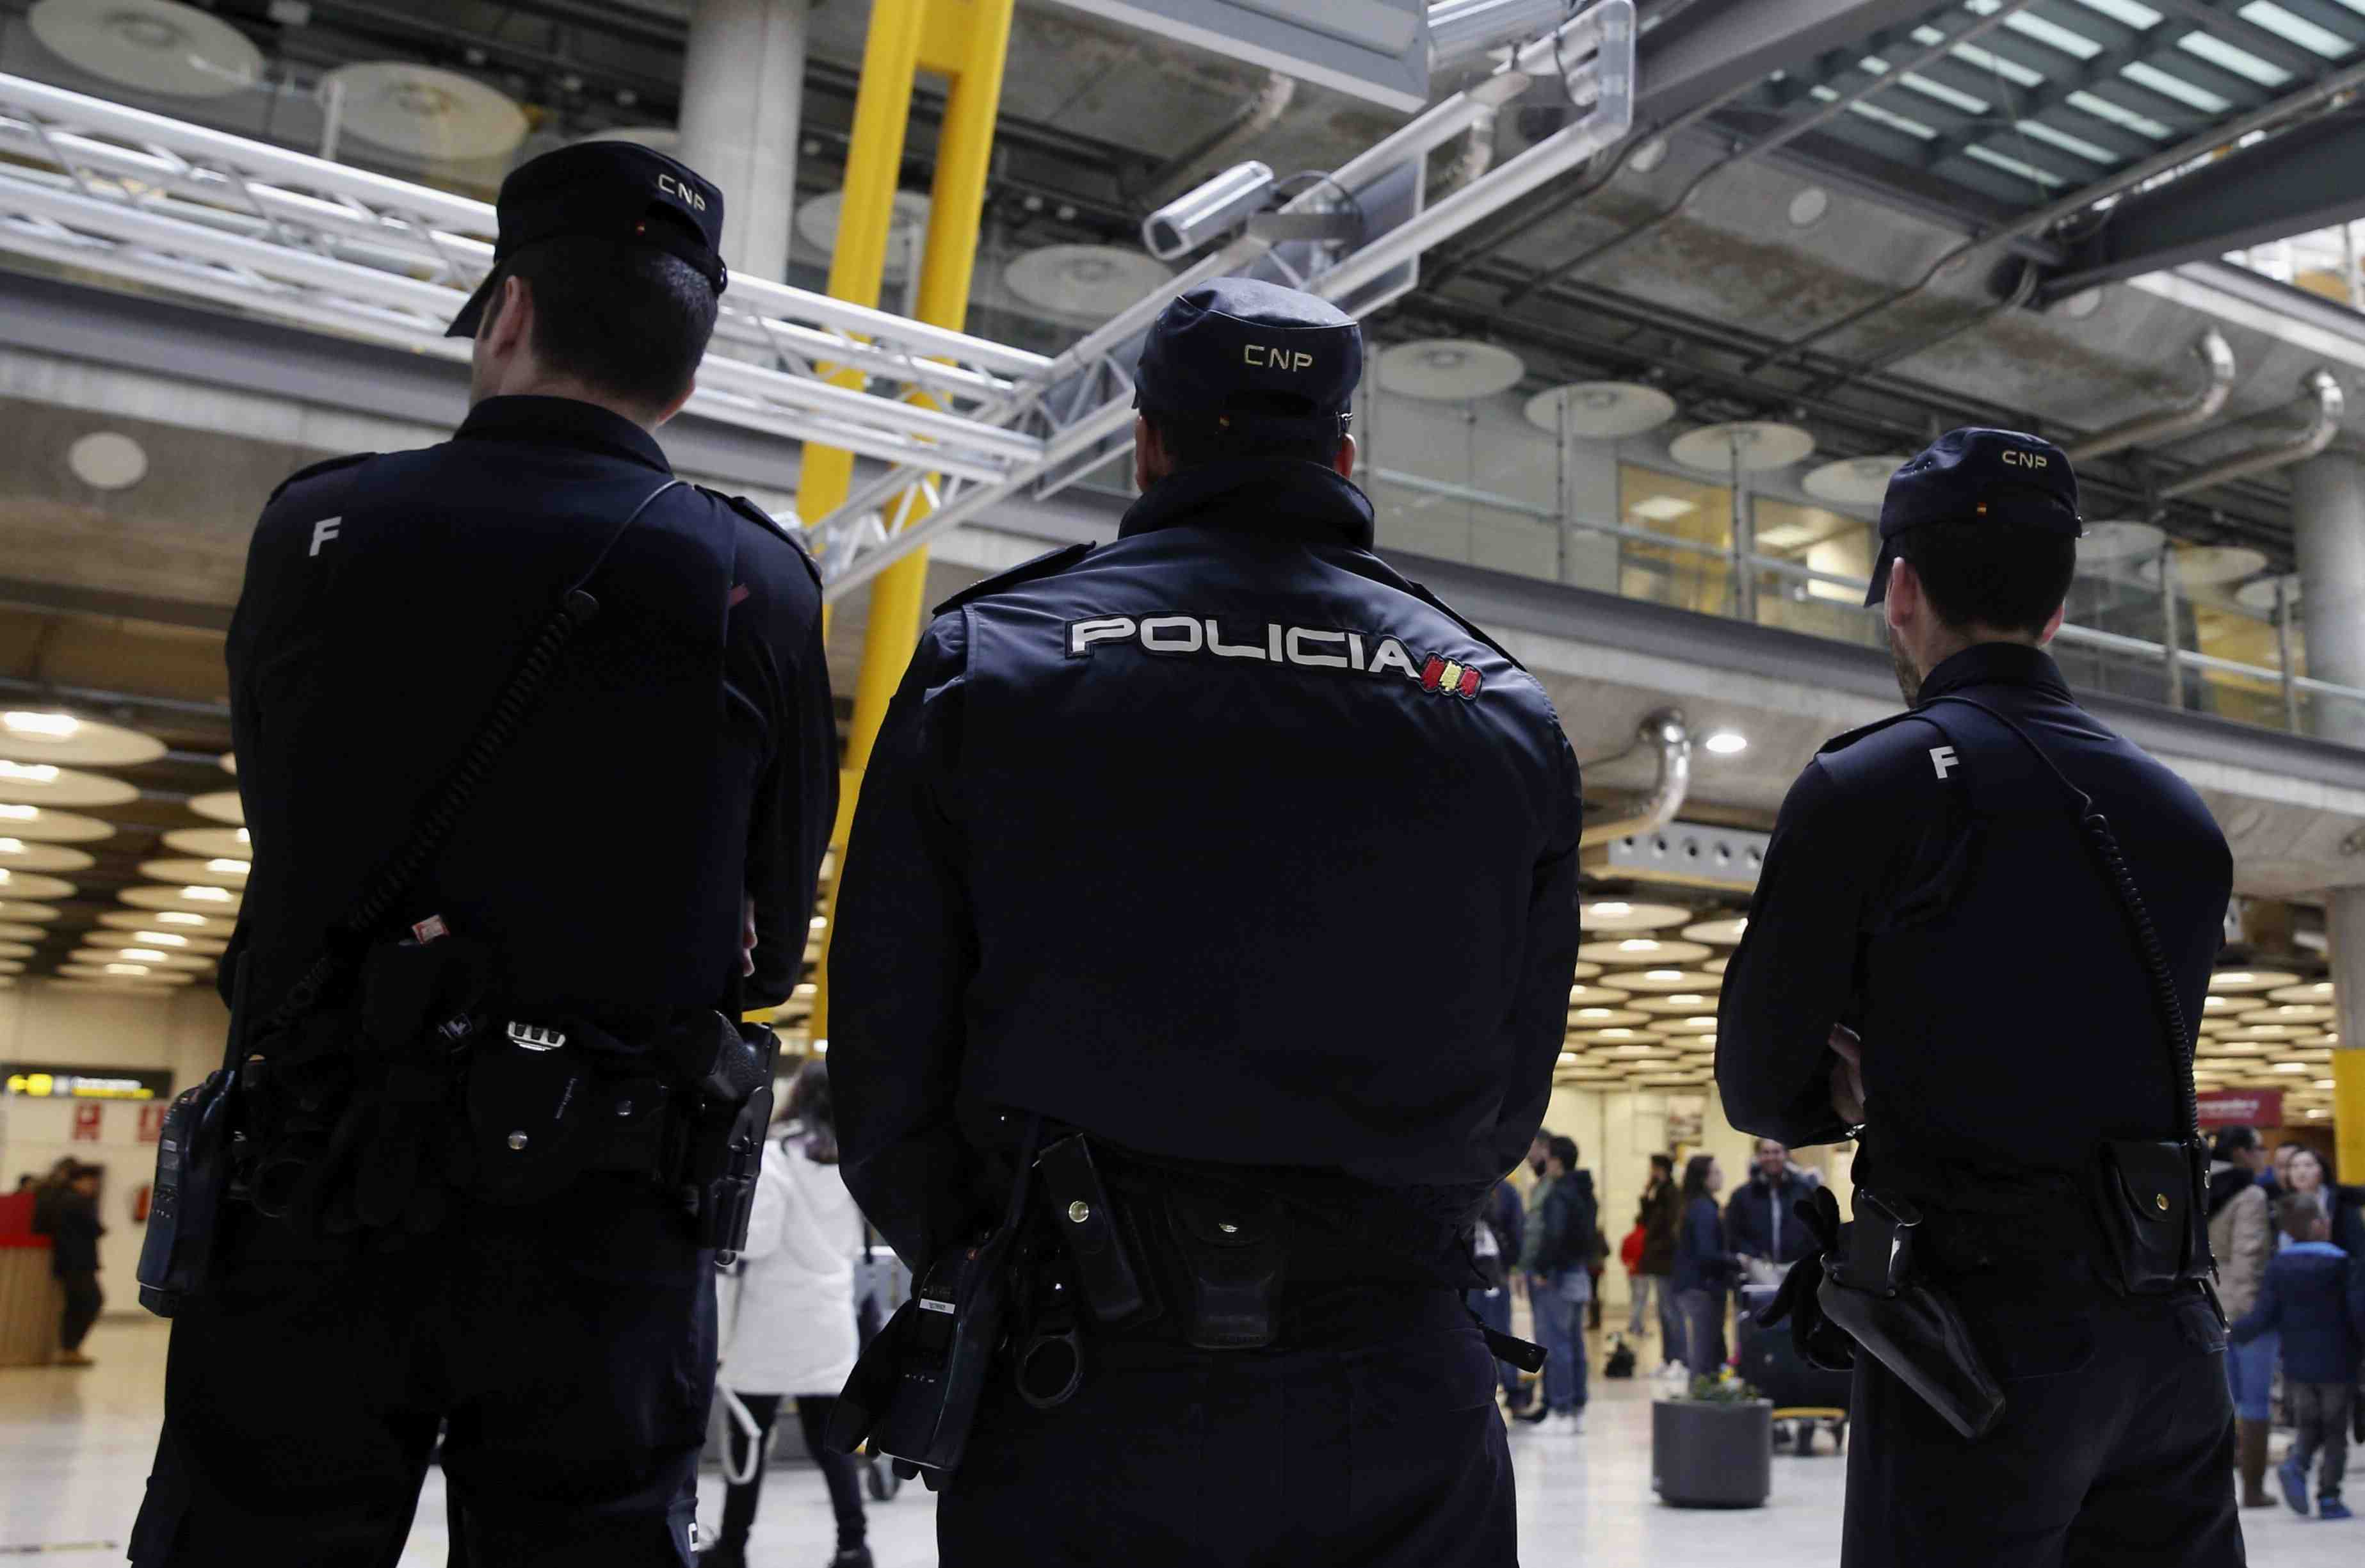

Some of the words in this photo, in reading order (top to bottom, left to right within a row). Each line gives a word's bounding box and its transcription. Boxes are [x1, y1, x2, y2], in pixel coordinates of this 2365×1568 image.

[658, 174, 706, 211] CNP
[1244, 344, 1313, 373] CNP
[2002, 450, 2047, 469] CNP
[309, 516, 342, 556] F
[1072, 617, 1421, 679] POLICIA
[1929, 746, 1959, 779] F
